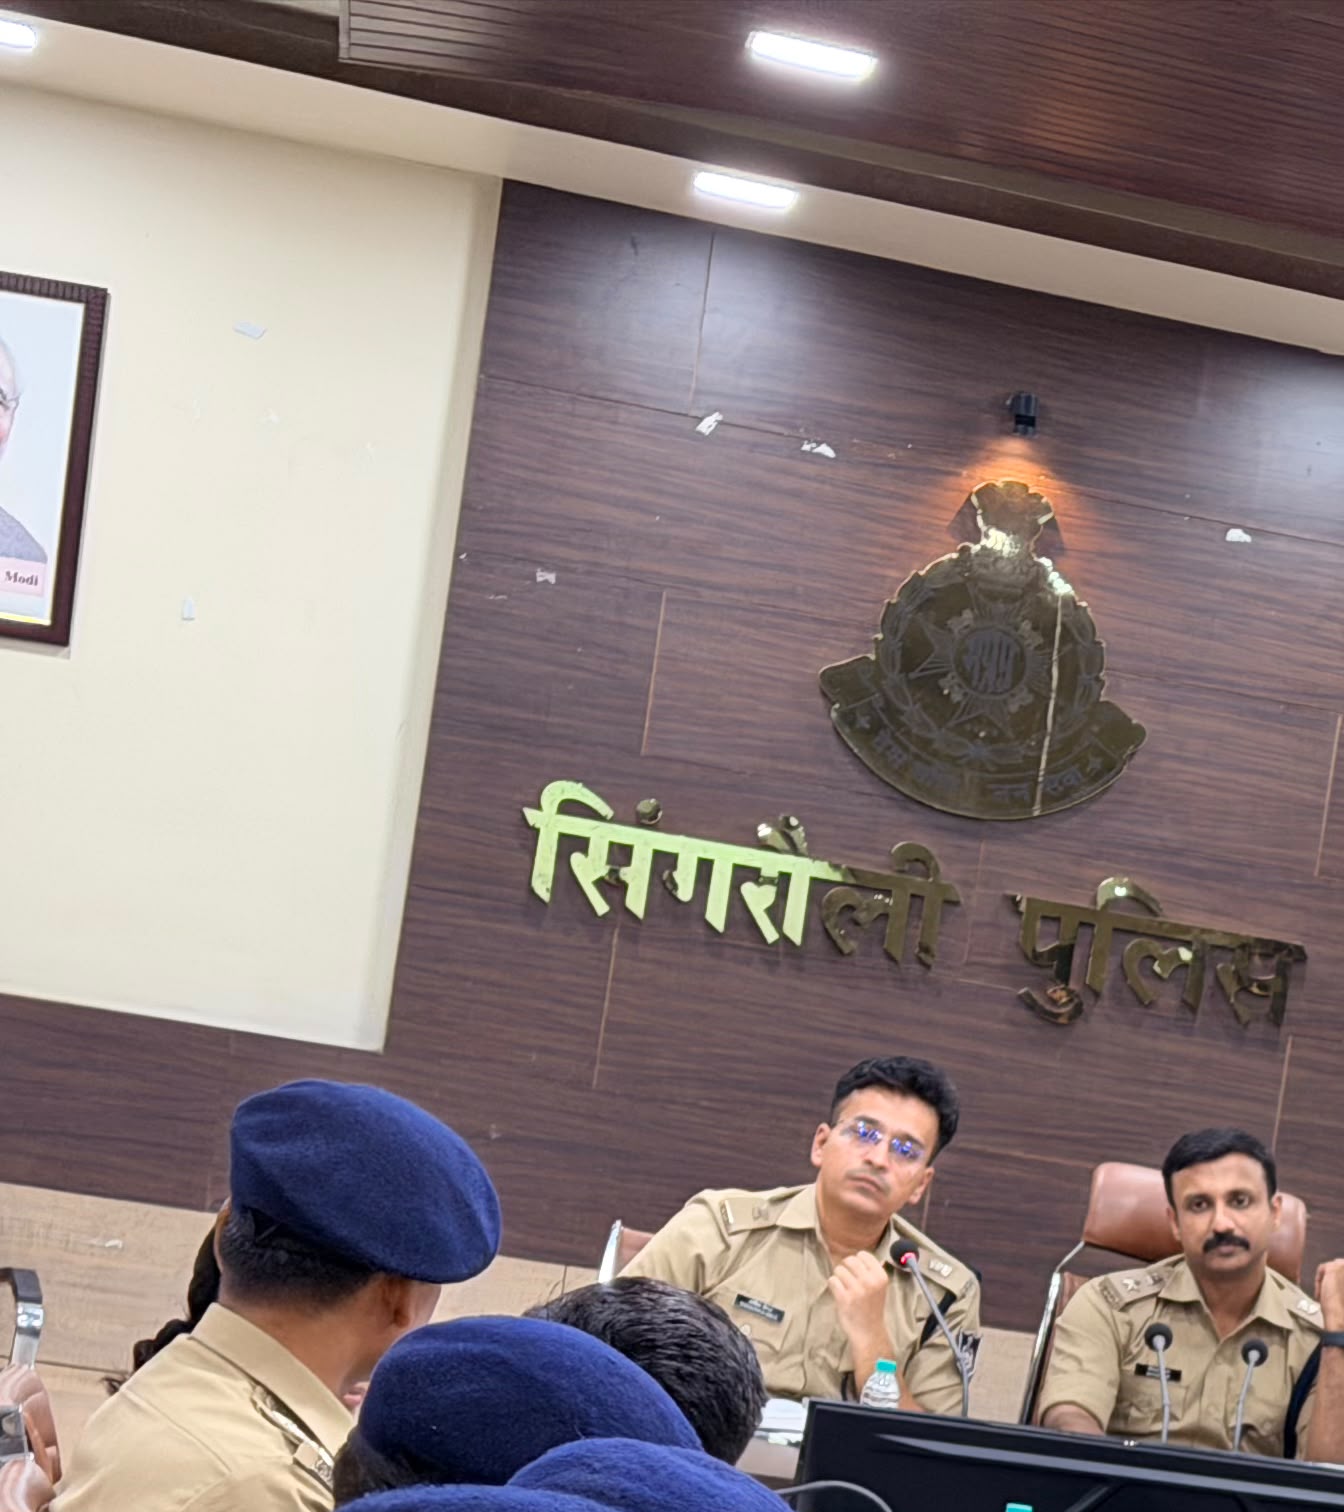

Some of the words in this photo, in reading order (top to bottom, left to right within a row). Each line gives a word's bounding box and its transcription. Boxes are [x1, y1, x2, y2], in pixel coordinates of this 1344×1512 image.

[5, 570, 39, 587] Modi
[522, 779, 961, 969] सिंगरौली
[1004, 876, 1308, 1026] पुलिस
